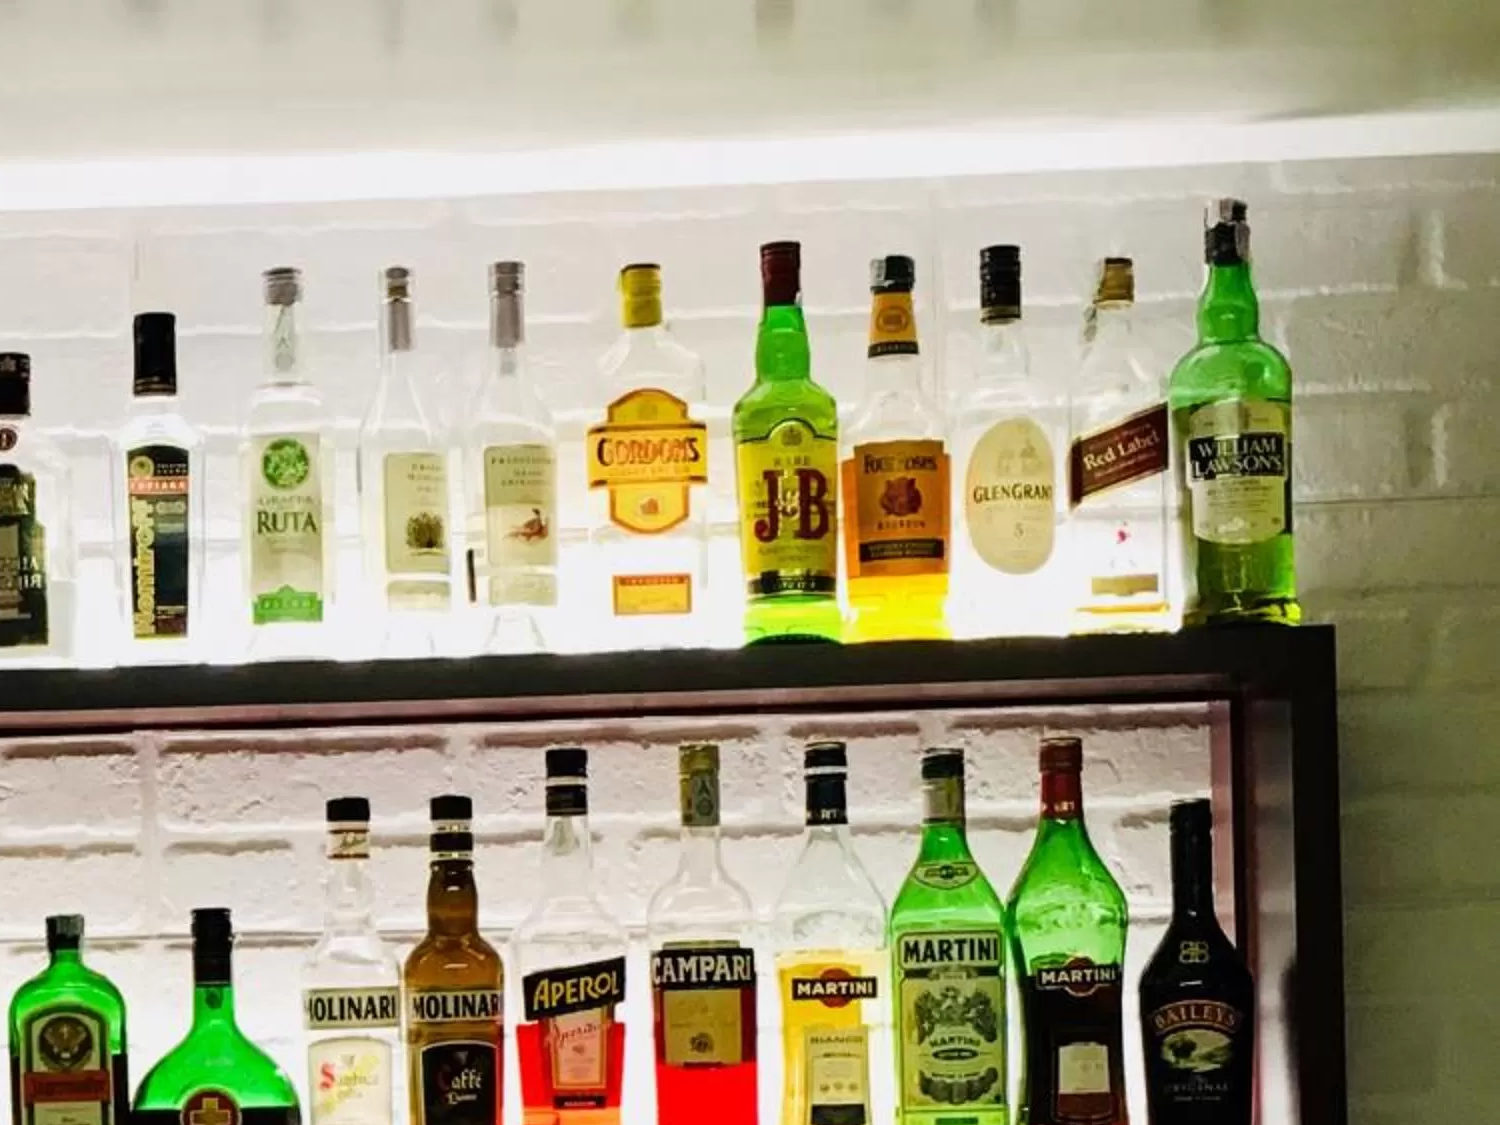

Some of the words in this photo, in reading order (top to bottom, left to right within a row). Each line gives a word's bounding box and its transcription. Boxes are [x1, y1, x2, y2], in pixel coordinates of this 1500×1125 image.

[1083, 446, 1117, 470] Red
[1197, 437, 1276, 458] WILLIAM
[973, 483, 1056, 504] GLENGRAN
[257, 511, 317, 535] RUTA
[903, 937, 998, 964] MARTINI
[652, 954, 751, 985] CAMPARI
[1041, 969, 1117, 985] MARTINI
[533, 971, 620, 1012] APEROL
[796, 980, 874, 997] MARTINI
[412, 993, 500, 1020] MOLINAR
[1155, 1004, 1236, 1029] BAILEYS
